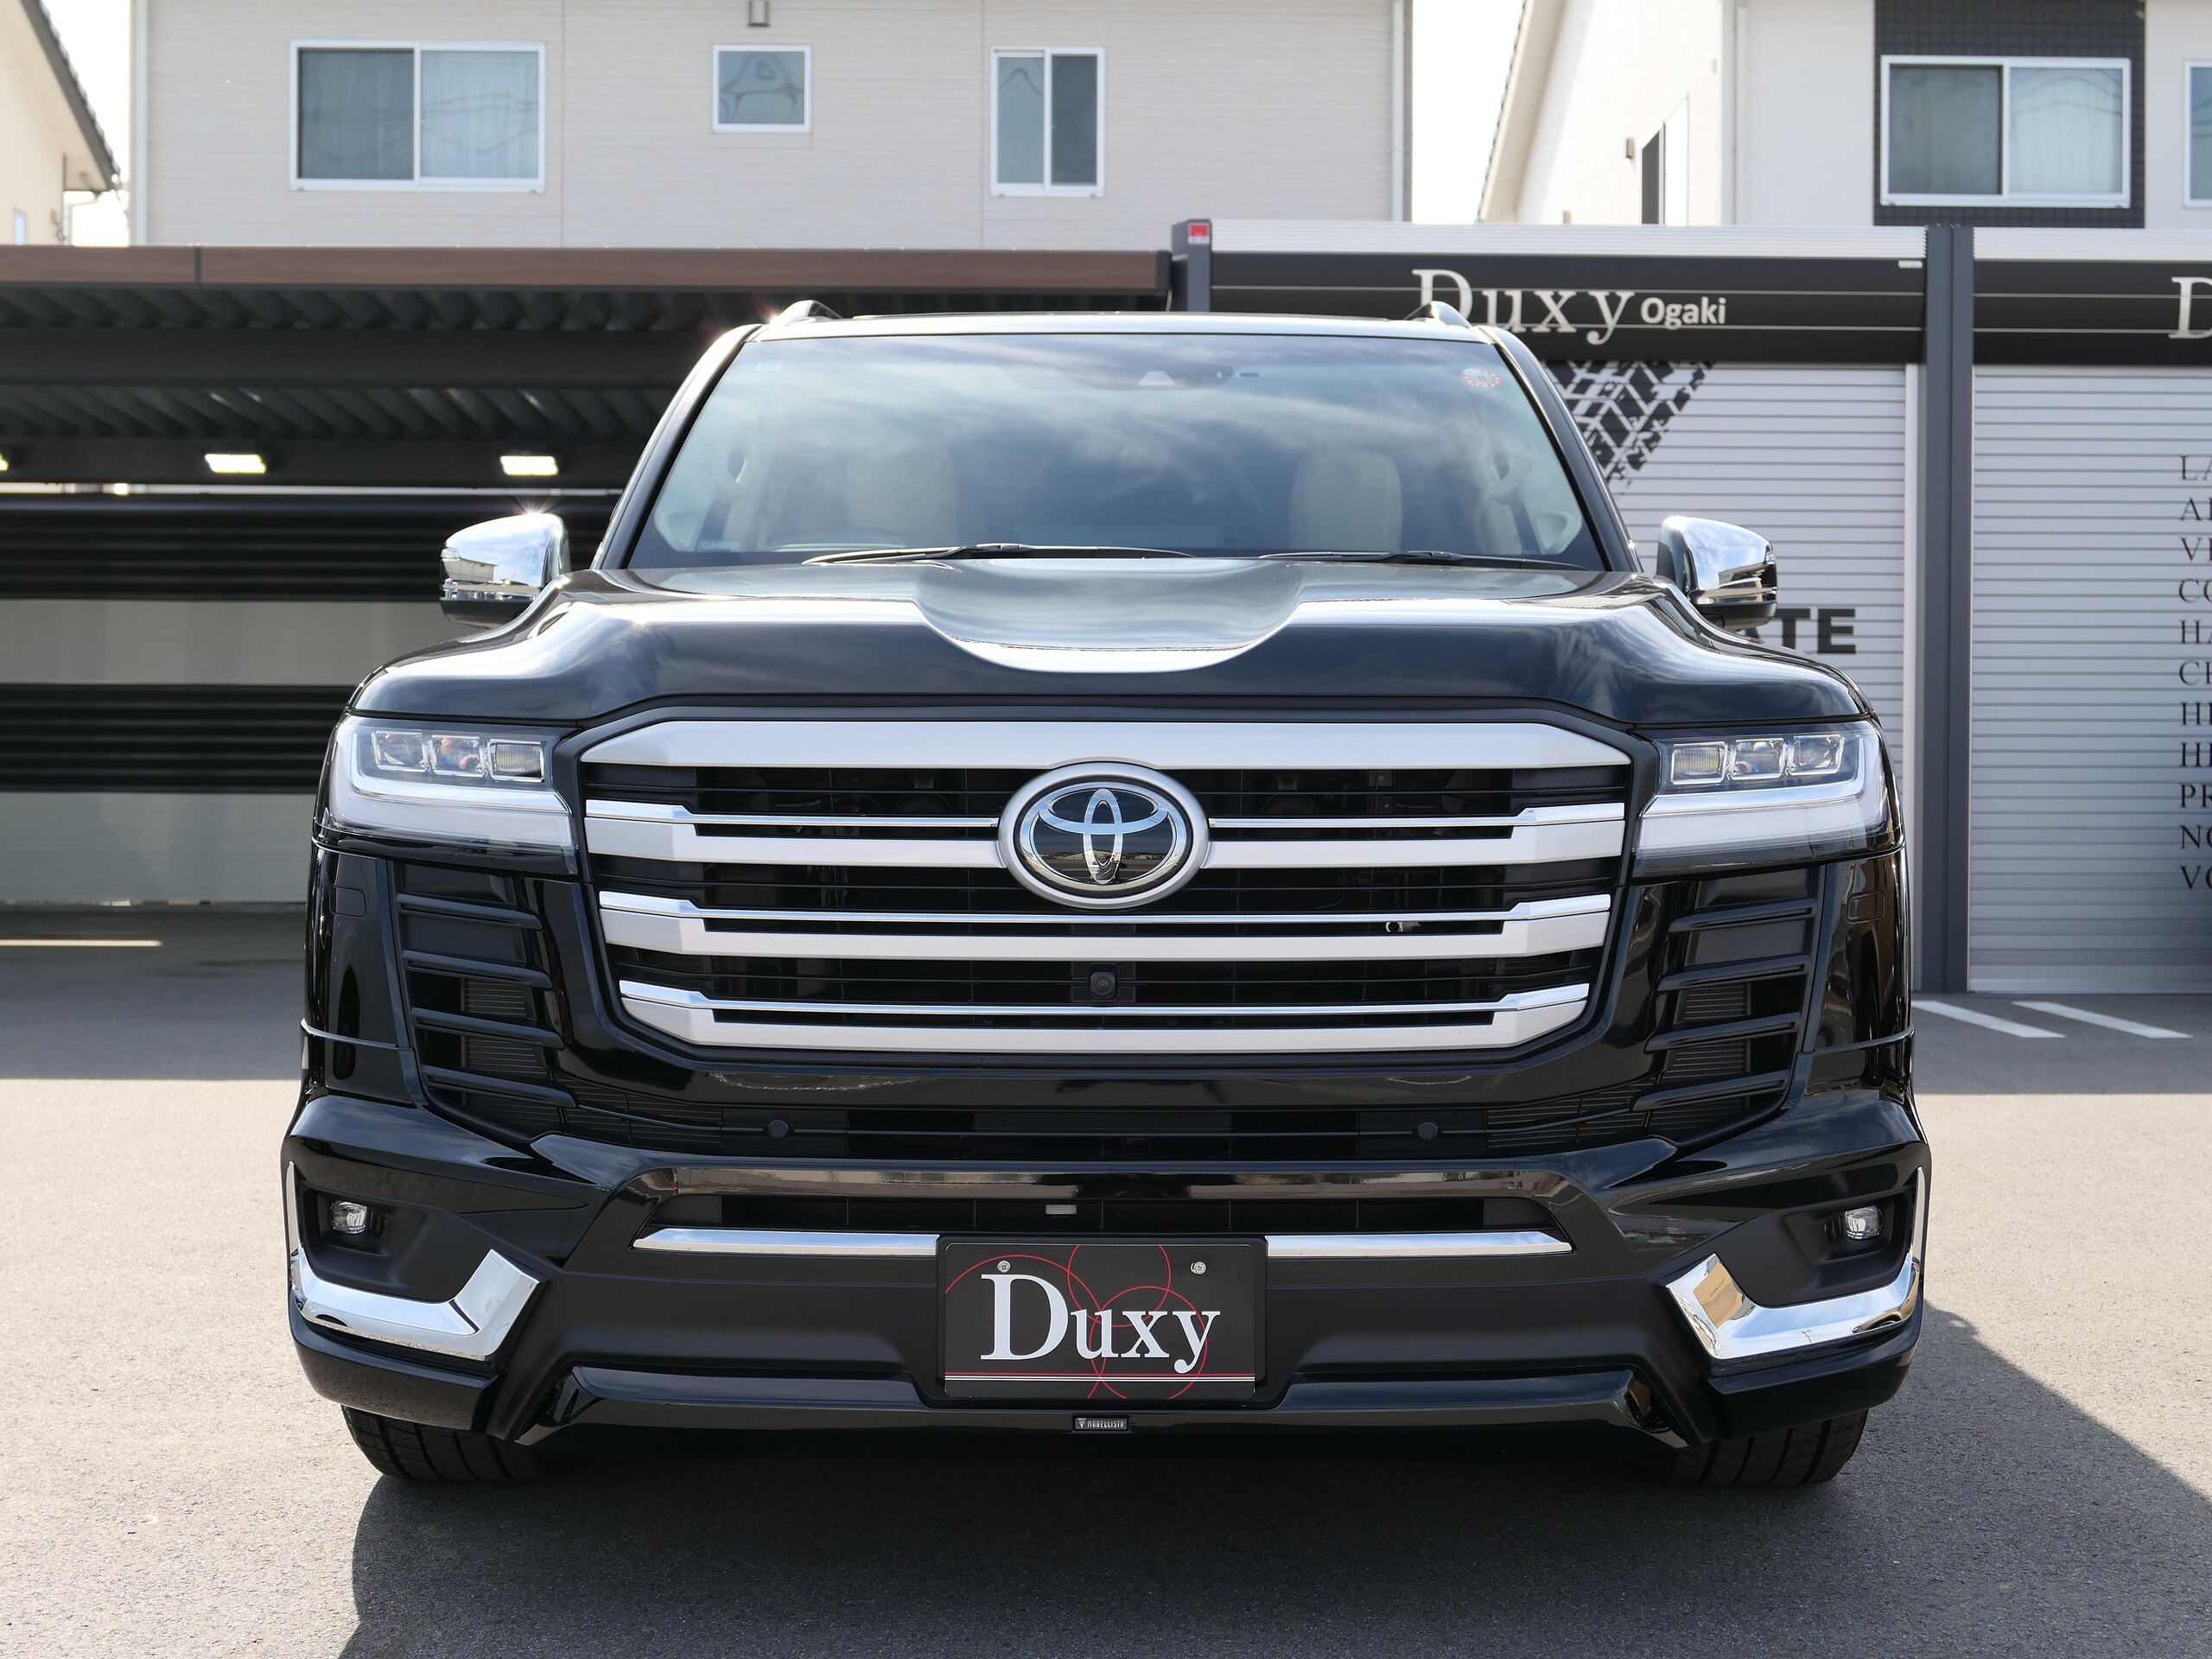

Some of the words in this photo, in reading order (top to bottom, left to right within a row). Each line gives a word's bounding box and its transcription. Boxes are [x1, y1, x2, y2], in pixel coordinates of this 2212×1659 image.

[1412, 268, 1636, 346] Duxy
[1642, 296, 1727, 330] Ogaki
[1744, 607, 1856, 654] TE
[2179, 620, 2212, 644] H
[2180, 702, 2212, 726] H
[2180, 741, 2212, 767] H
[2179, 825, 2212, 849] N
[981, 1274, 1221, 1374] Duxy
[1087, 1420, 1124, 1428] MODELLISTA
